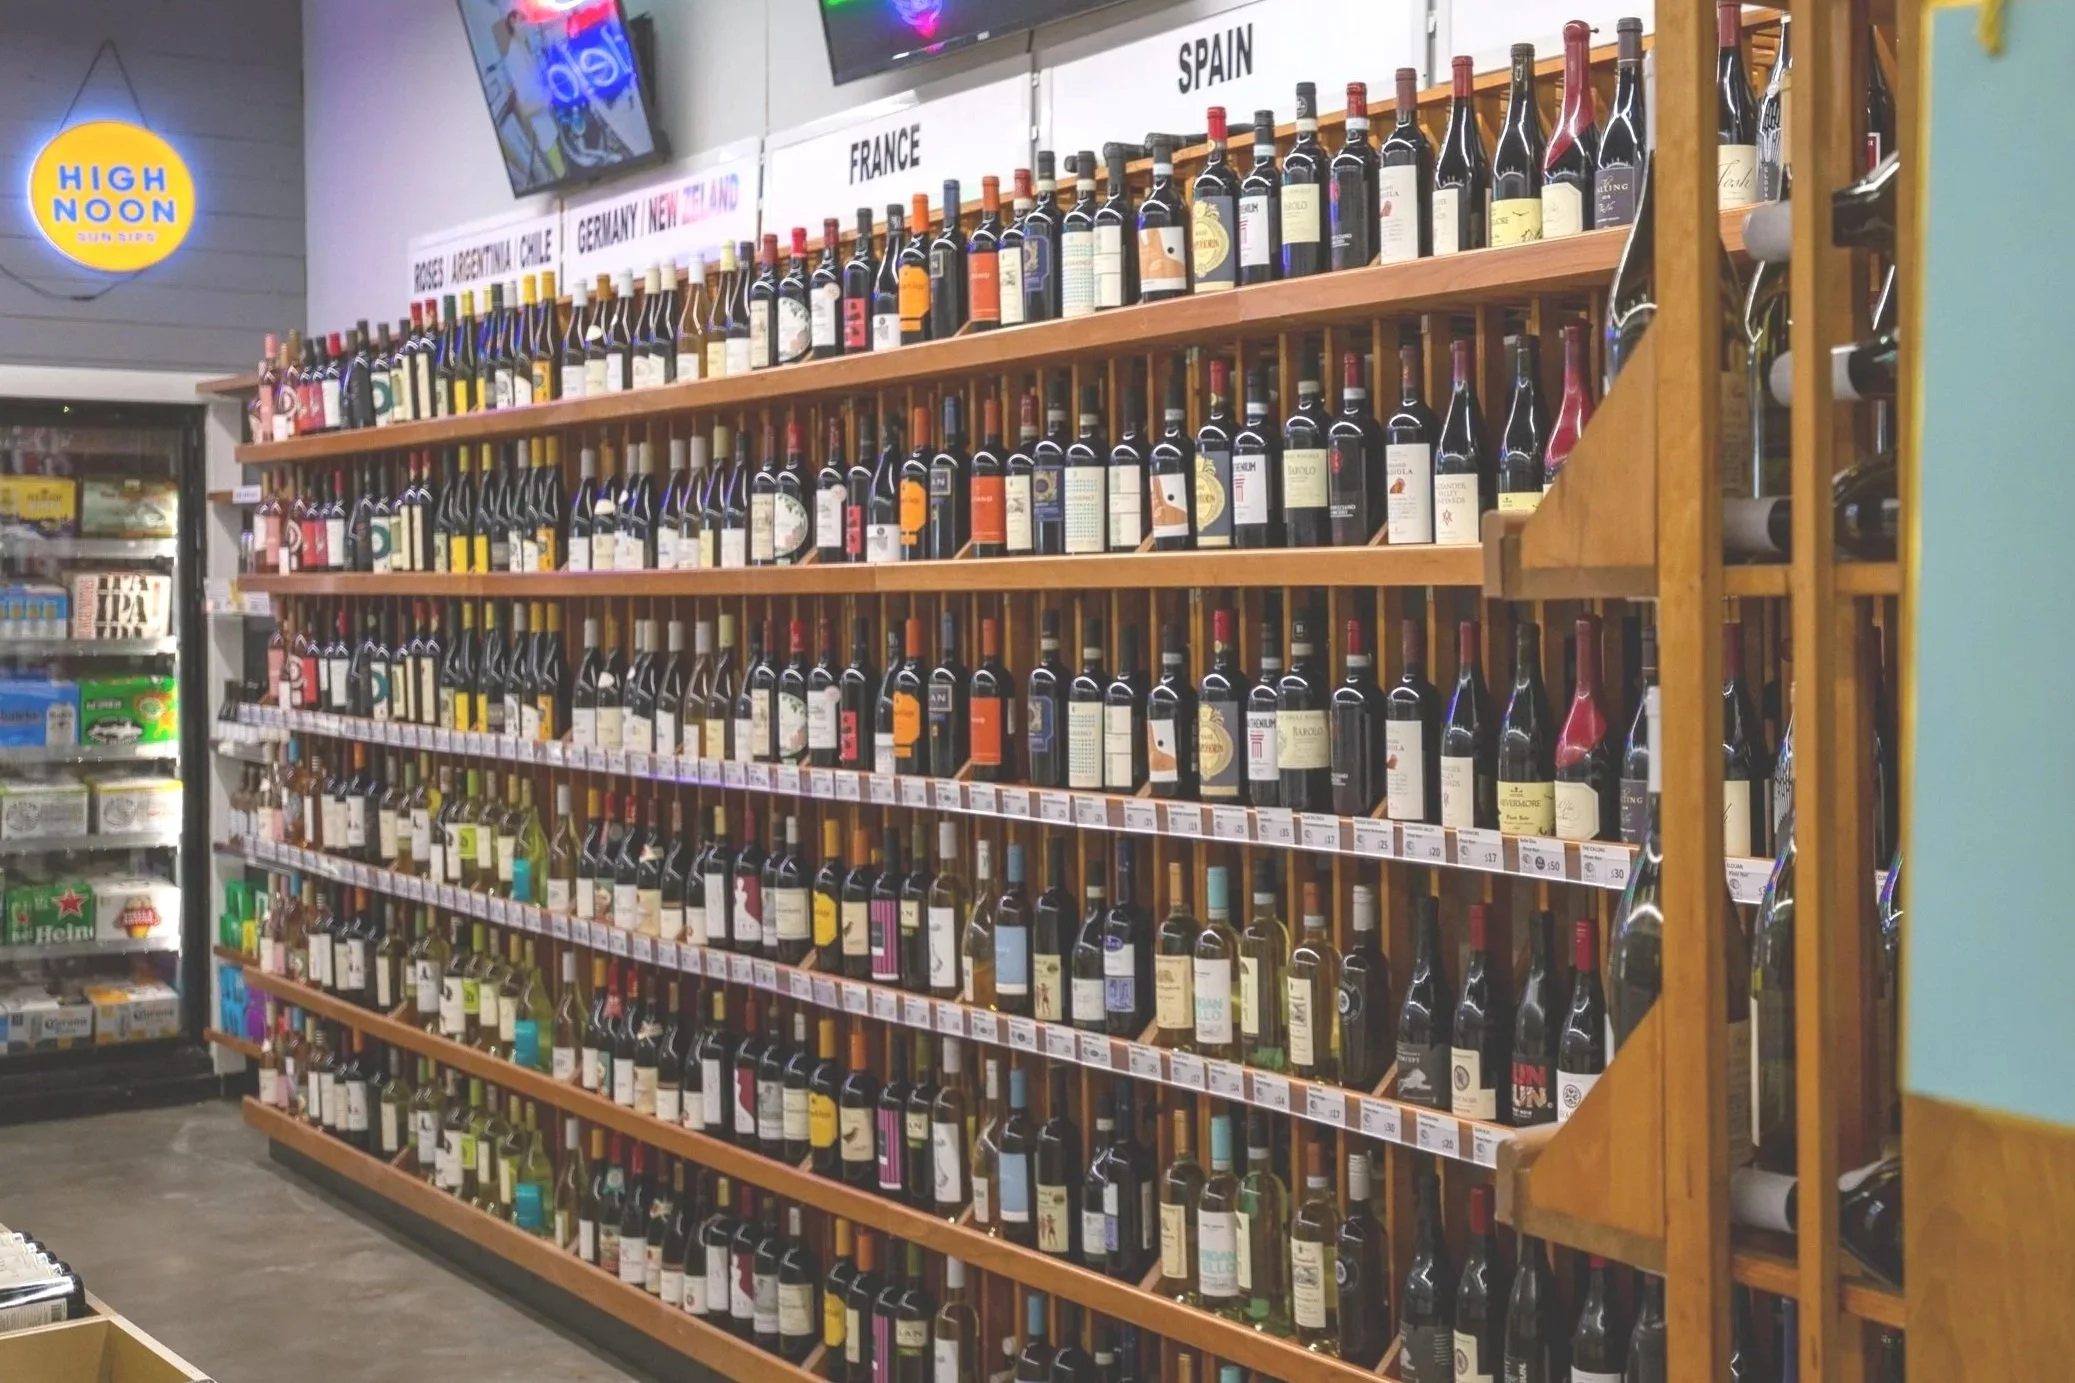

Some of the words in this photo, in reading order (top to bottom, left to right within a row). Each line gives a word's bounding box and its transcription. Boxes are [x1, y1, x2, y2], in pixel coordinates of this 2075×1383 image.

[1178, 23, 1253, 94] SPAIN
[849, 124, 921, 185] FRANCE
[59, 165, 165, 191] HIGH
[53, 198, 175, 223] NOON
[577, 203, 638, 254] GERMANY
[647, 190, 679, 235] NEW
[680, 172, 740, 226] ZELAND
[77, 232, 111, 242] SUN
[118, 232, 155, 243] SIPS
[414, 257, 444, 293] ROSES
[519, 228, 552, 268] CHILE
[1484, 852, 1497, 863] $17
[1546, 860, 1560, 871] $50
[1610, 868, 1624, 879] $30
